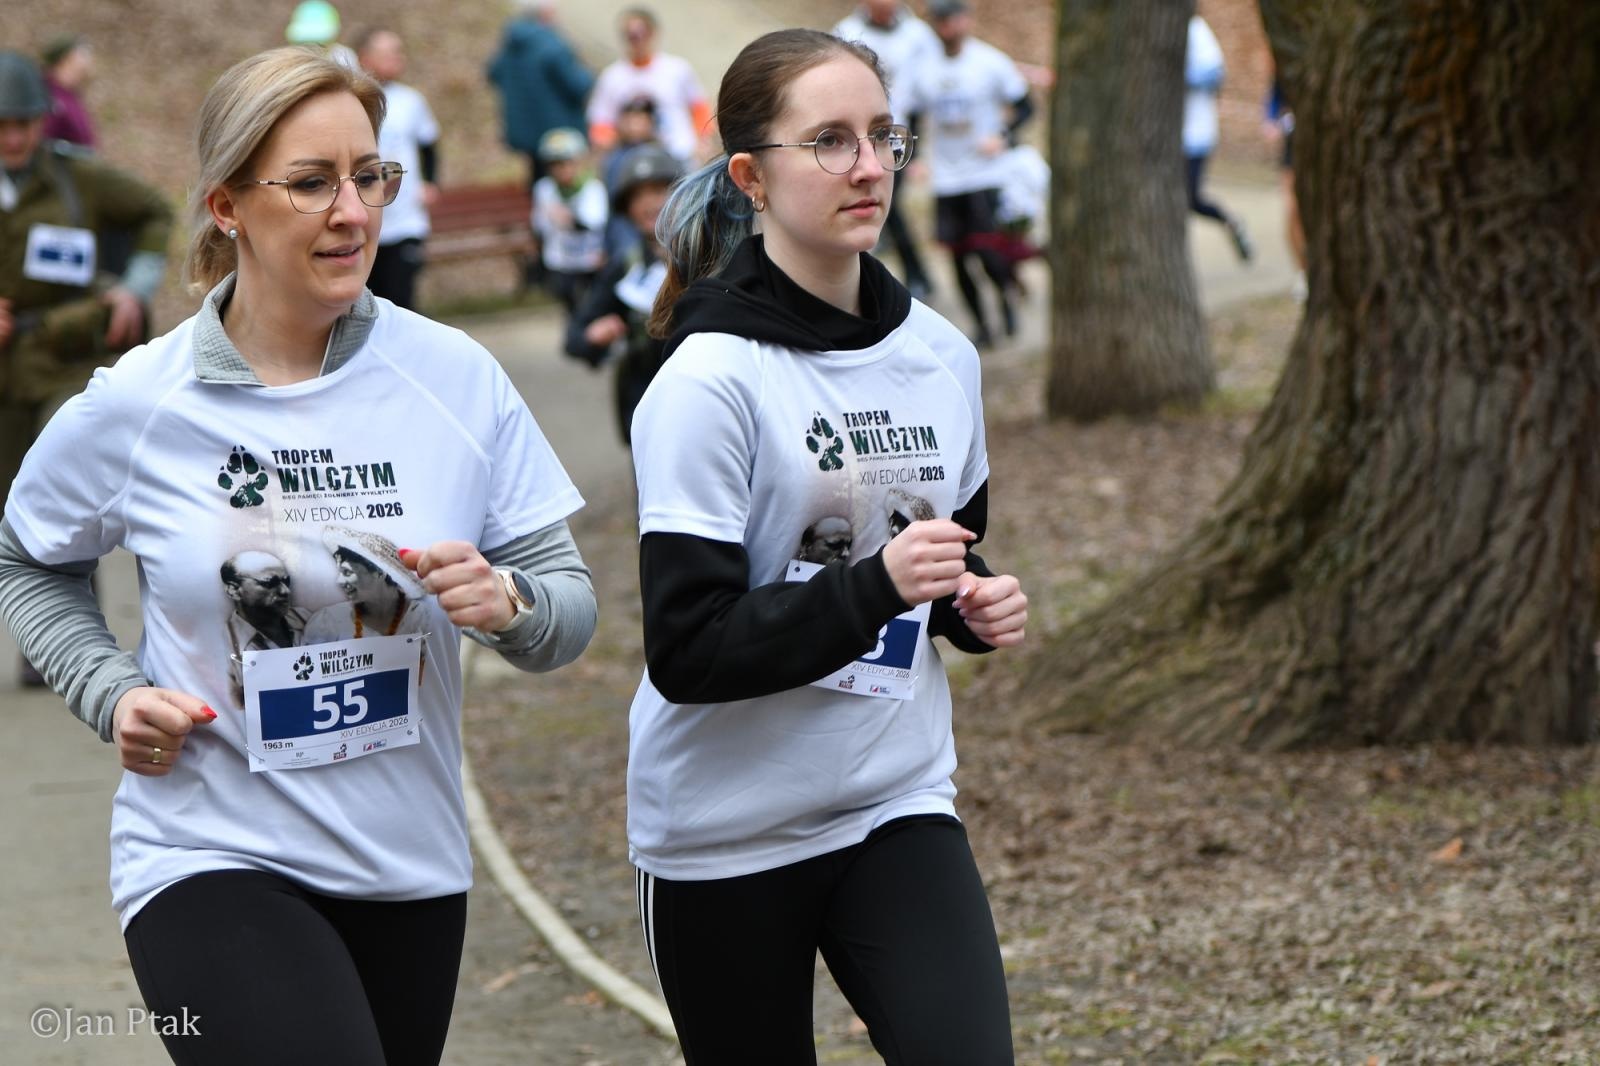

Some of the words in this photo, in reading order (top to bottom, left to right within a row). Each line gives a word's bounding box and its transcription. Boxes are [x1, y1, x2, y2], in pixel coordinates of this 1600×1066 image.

[843, 410, 892, 428] TROPEM
[849, 426, 938, 455] WILCZYM
[272, 448, 334, 465] TROPEM
[277, 462, 396, 493] WILCZYM
[860, 471, 877, 485] XIV
[879, 467, 918, 485] EDYCJA
[919, 465, 945, 482] 2026
[284, 508, 307, 523] XIV
[311, 505, 365, 522] EDYCJA
[366, 502, 404, 519] 2026
[319, 649, 348, 661] TROPEM
[321, 653, 374, 675] WILCZYM
[896, 669, 910, 679] 2026
[313, 679, 369, 730] 55
[340, 729, 354, 739] XIV
[356, 722, 388, 736] EDYCJA
[389, 716, 409, 728] 2026
[263, 741, 283, 750] 1963
